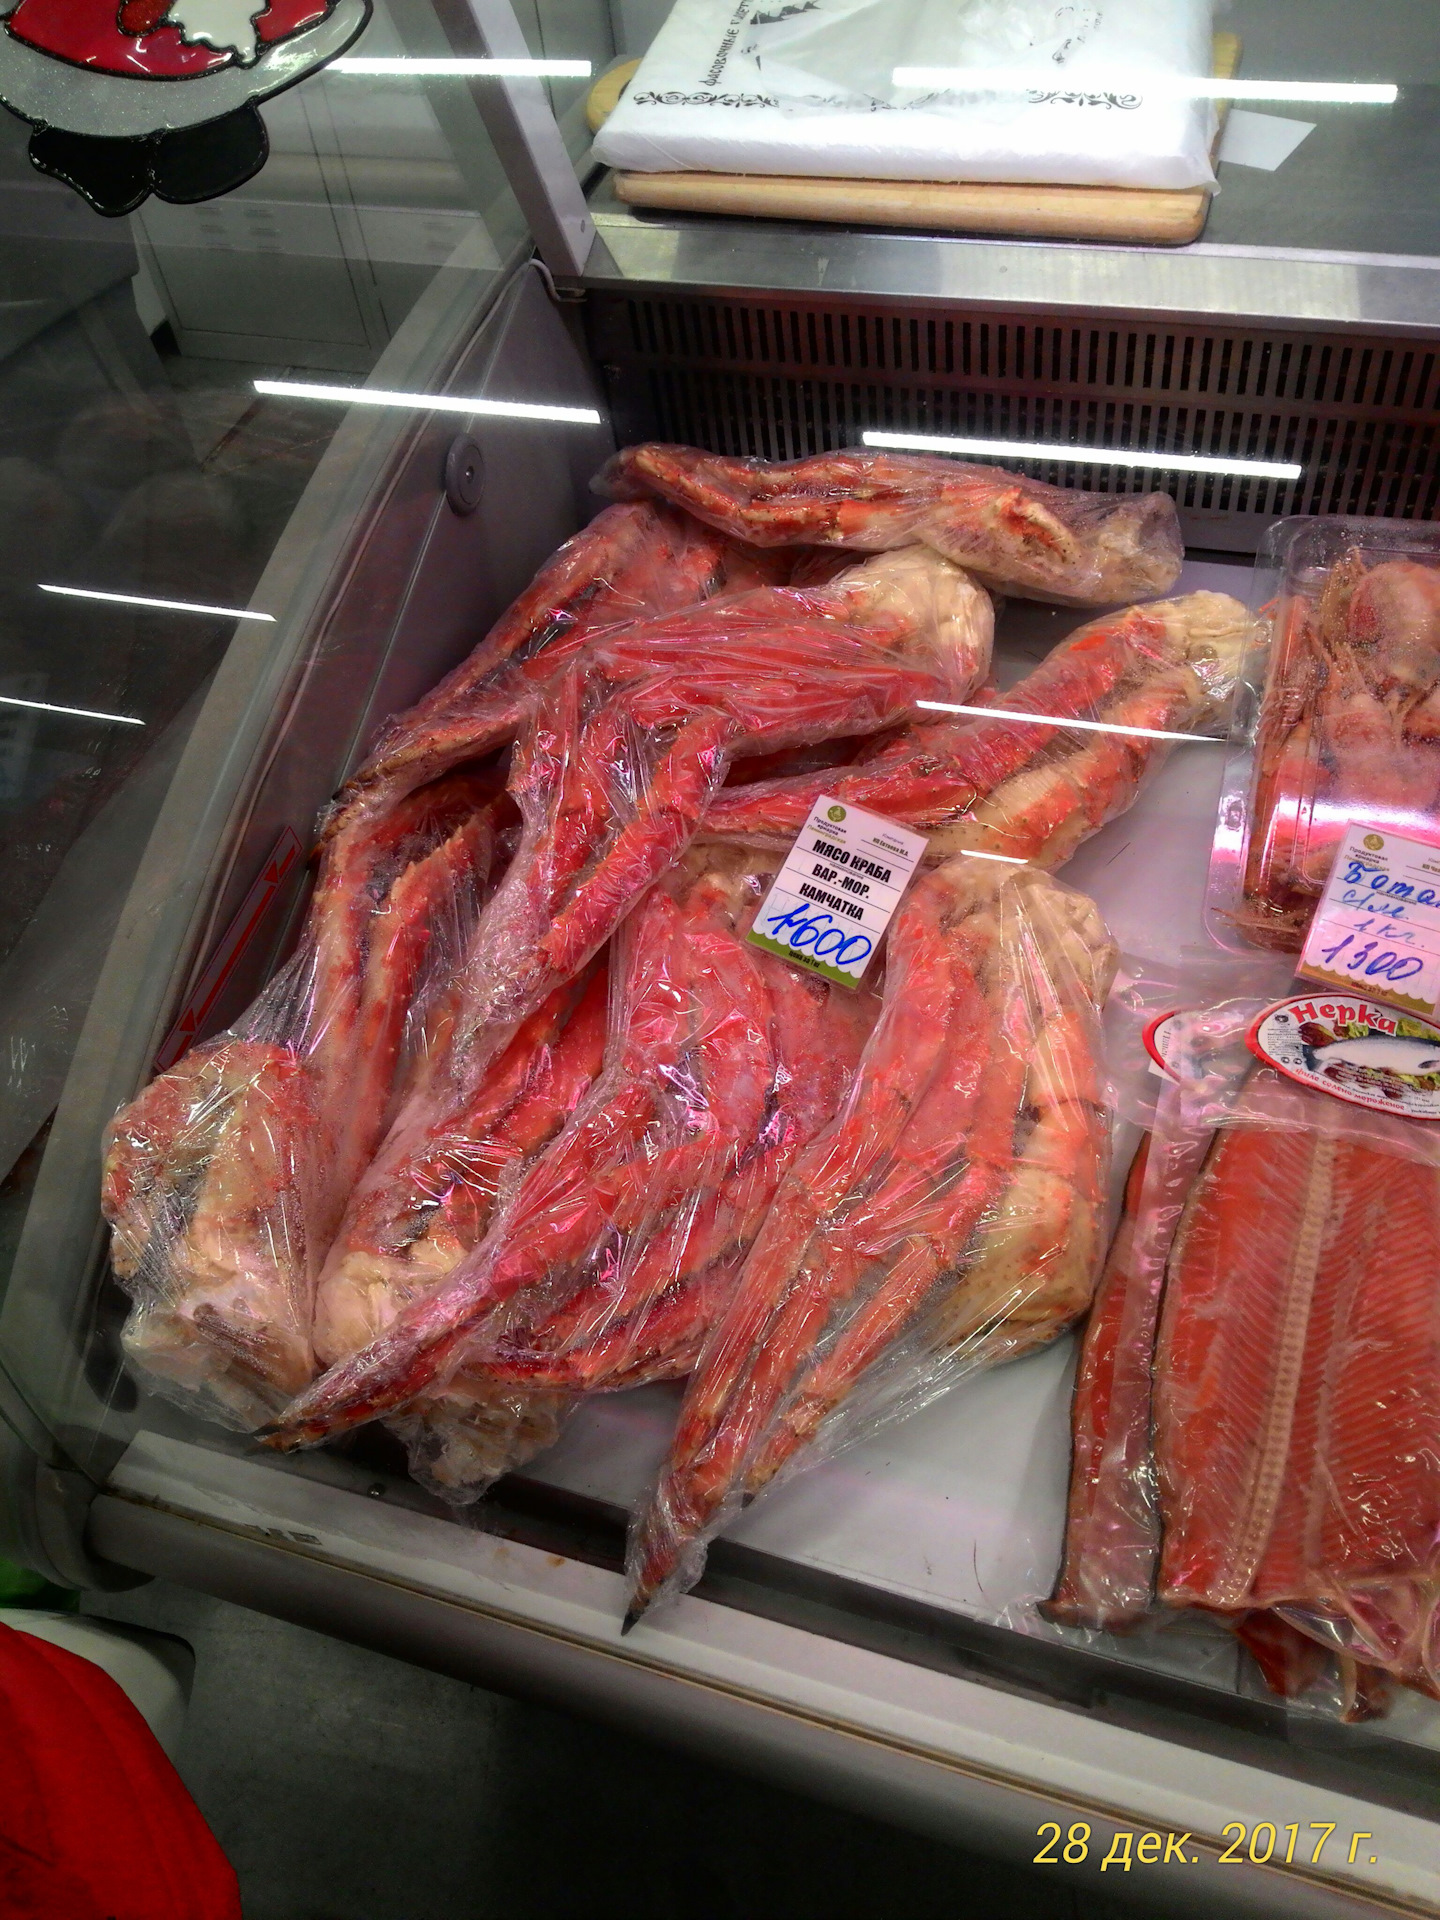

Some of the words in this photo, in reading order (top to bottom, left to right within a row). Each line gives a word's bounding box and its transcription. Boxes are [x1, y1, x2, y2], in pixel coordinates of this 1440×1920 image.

[812, 839, 850, 865] МЯСО
[850, 855, 892, 883] КРАБА
[811, 863, 870, 899] ВАР.-МОР.
[798, 882, 864, 921] КАМЧАТКА
[1288, 1001, 1397, 1035] Нерка
[1294, 1067, 1319, 1082] филе
